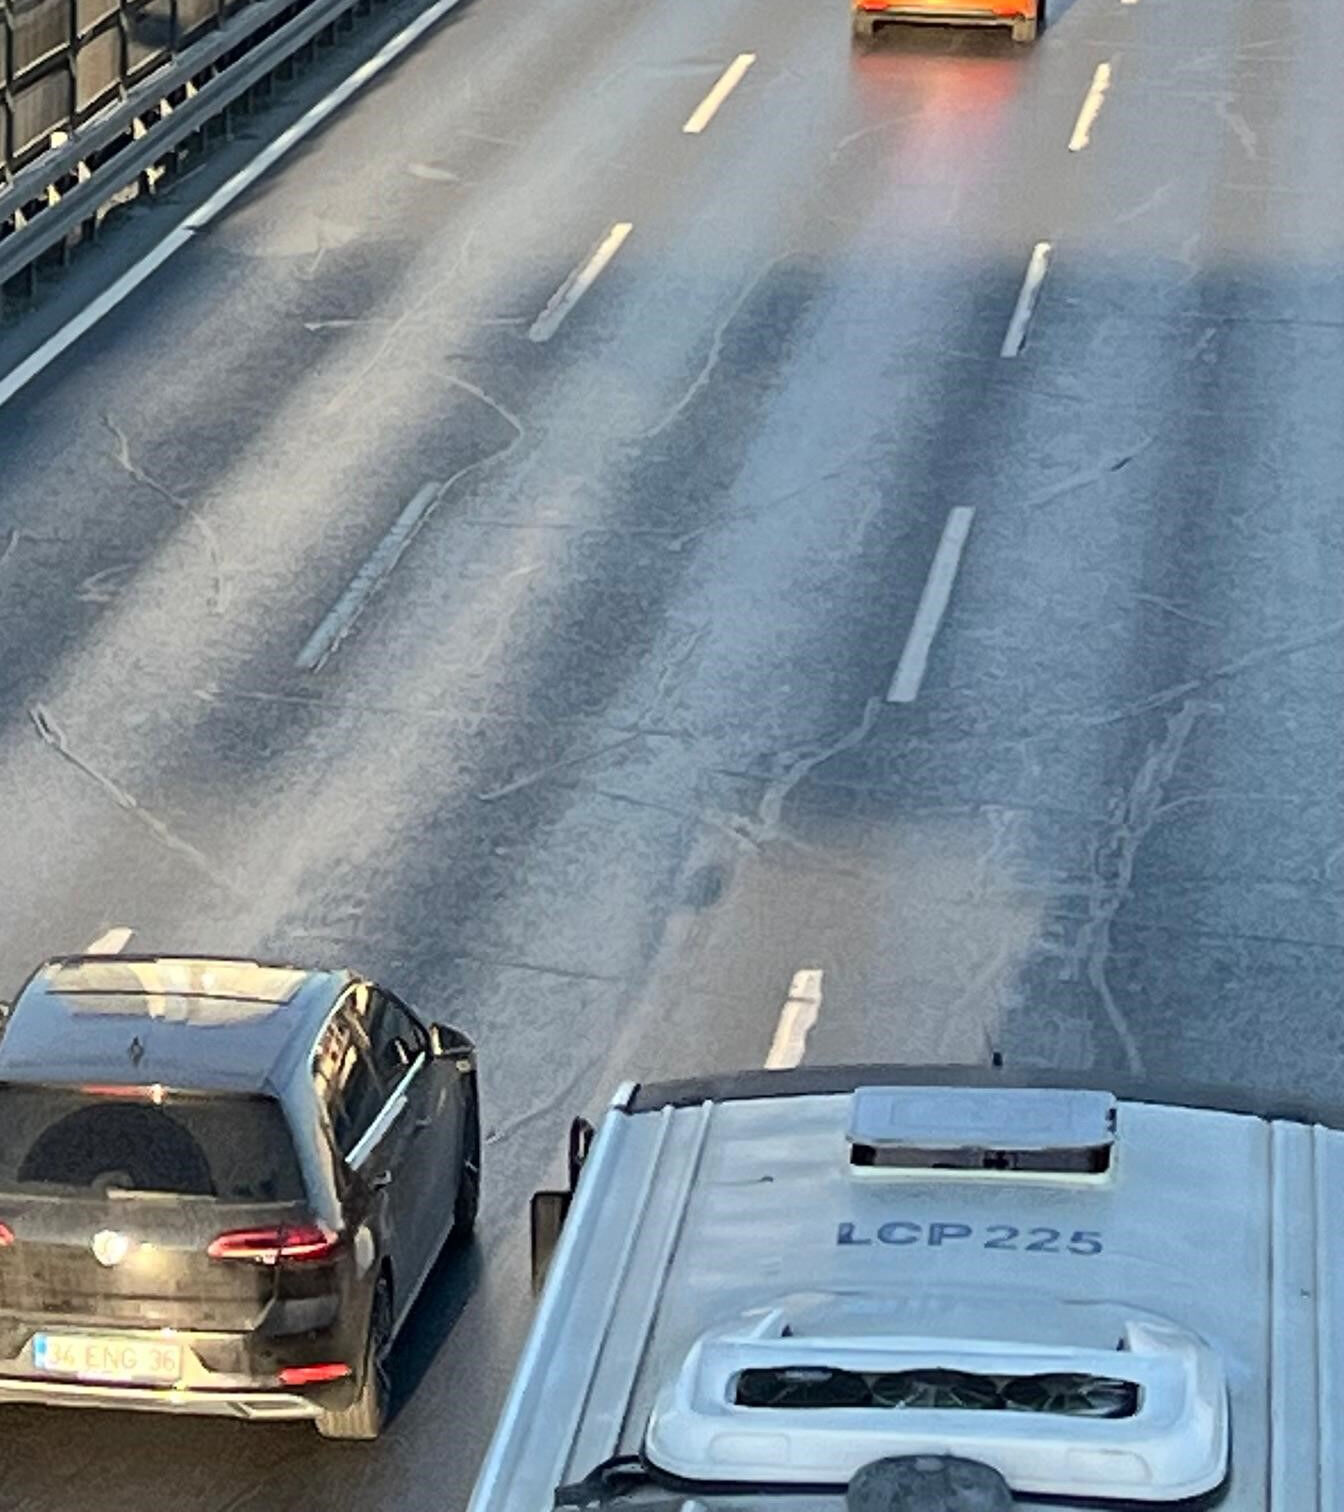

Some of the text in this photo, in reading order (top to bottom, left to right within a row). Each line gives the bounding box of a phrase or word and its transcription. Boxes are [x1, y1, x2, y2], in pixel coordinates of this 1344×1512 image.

[834, 1220, 1106, 1258] LCP 225
[84, 1345, 138, 1370] ENG
